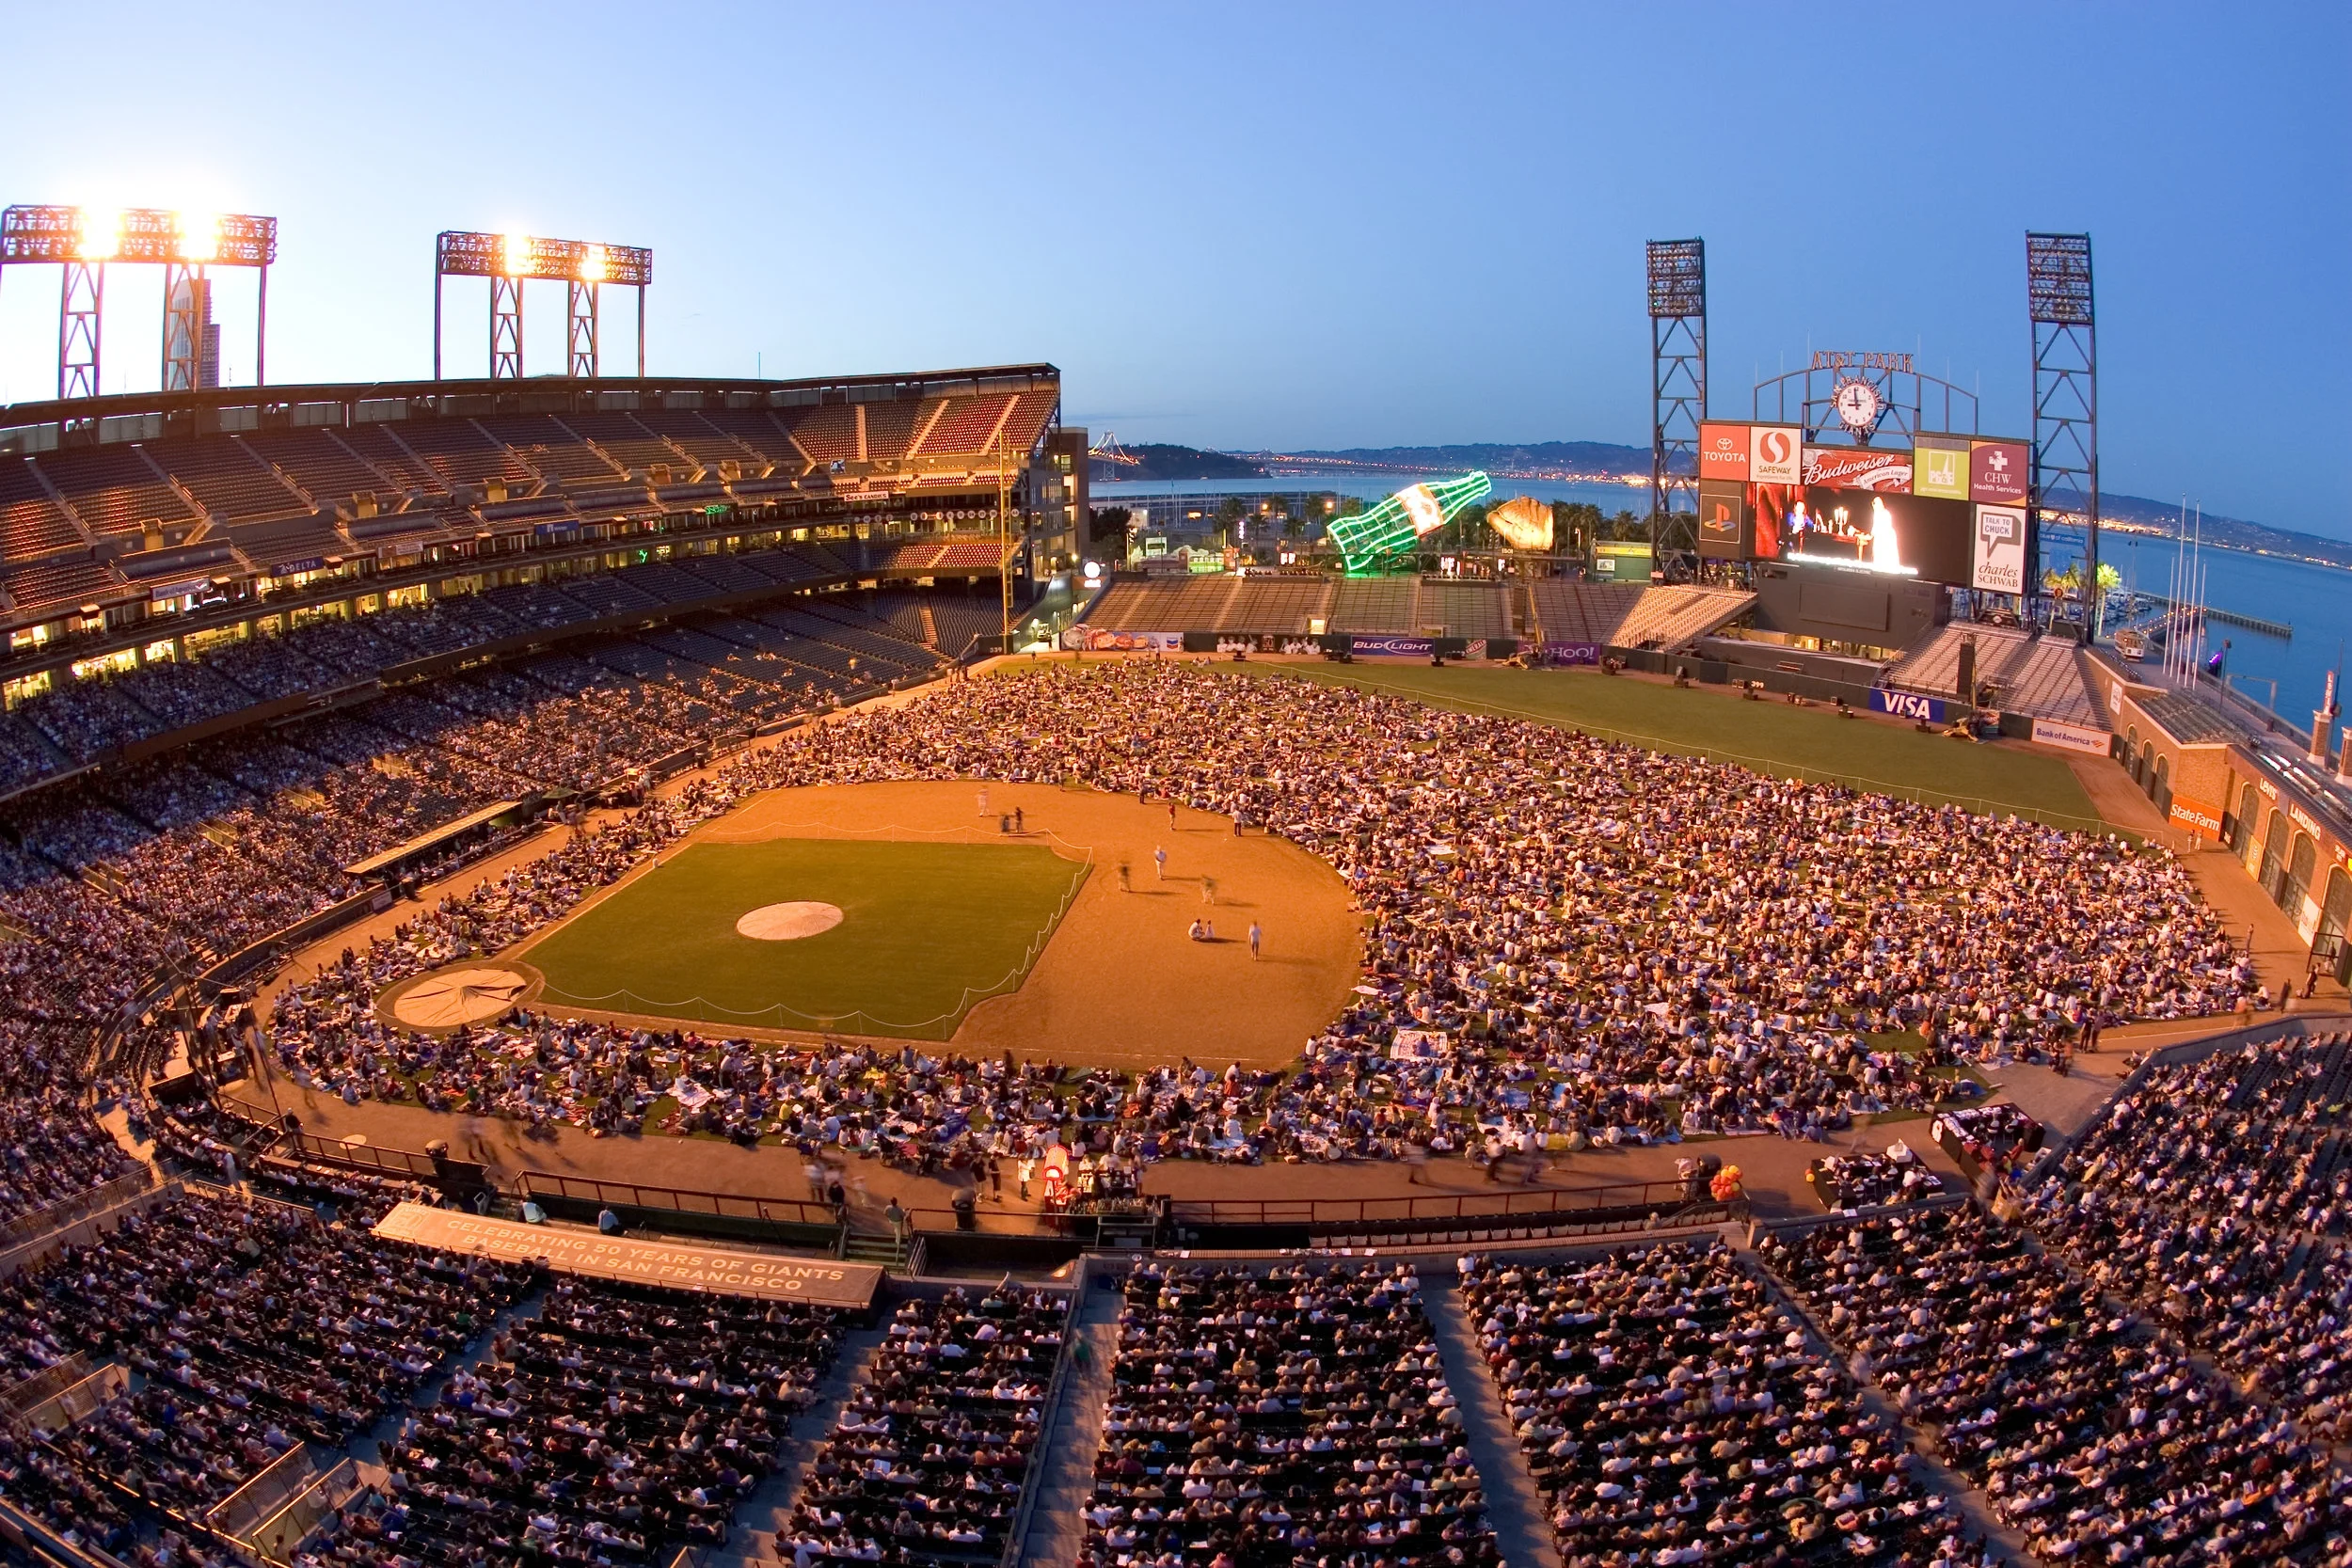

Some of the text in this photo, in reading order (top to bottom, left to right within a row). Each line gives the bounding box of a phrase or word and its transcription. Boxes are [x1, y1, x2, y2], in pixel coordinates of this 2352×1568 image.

[1812, 351, 1914, 373] AT&T PARK
[1830, 375, 1886, 410] SAN FRANCISCO
[1838, 420, 1876, 435] GIANTS
[1704, 451, 1746, 462] TOYOTA
[1758, 466, 1791, 474] SAFEWAY
[1803, 454, 1895, 485] Budweiser
[1863, 470, 1890, 483] American
[1984, 472, 2011, 484] CHW
[1995, 485, 2022, 494] Services
[1985, 516, 2000, 525] TALK
[1984, 525, 2010, 535] CHUCK
[289, 561, 317, 572] DELTA
[1979, 562, 2018, 578] charles
[1978, 575, 2018, 588] SCHWAB
[1882, 691, 1931, 720] VISA
[2036, 728, 2053, 737] Bank
[2061, 733, 2090, 746] America
[2289, 803, 2321, 841] LANDING
[448, 1220, 845, 1281] CELEBRATING 50 YEARS OF GIANTS
[463, 1235, 803, 1291] BASEBALL IN SAN FRANCISCO
